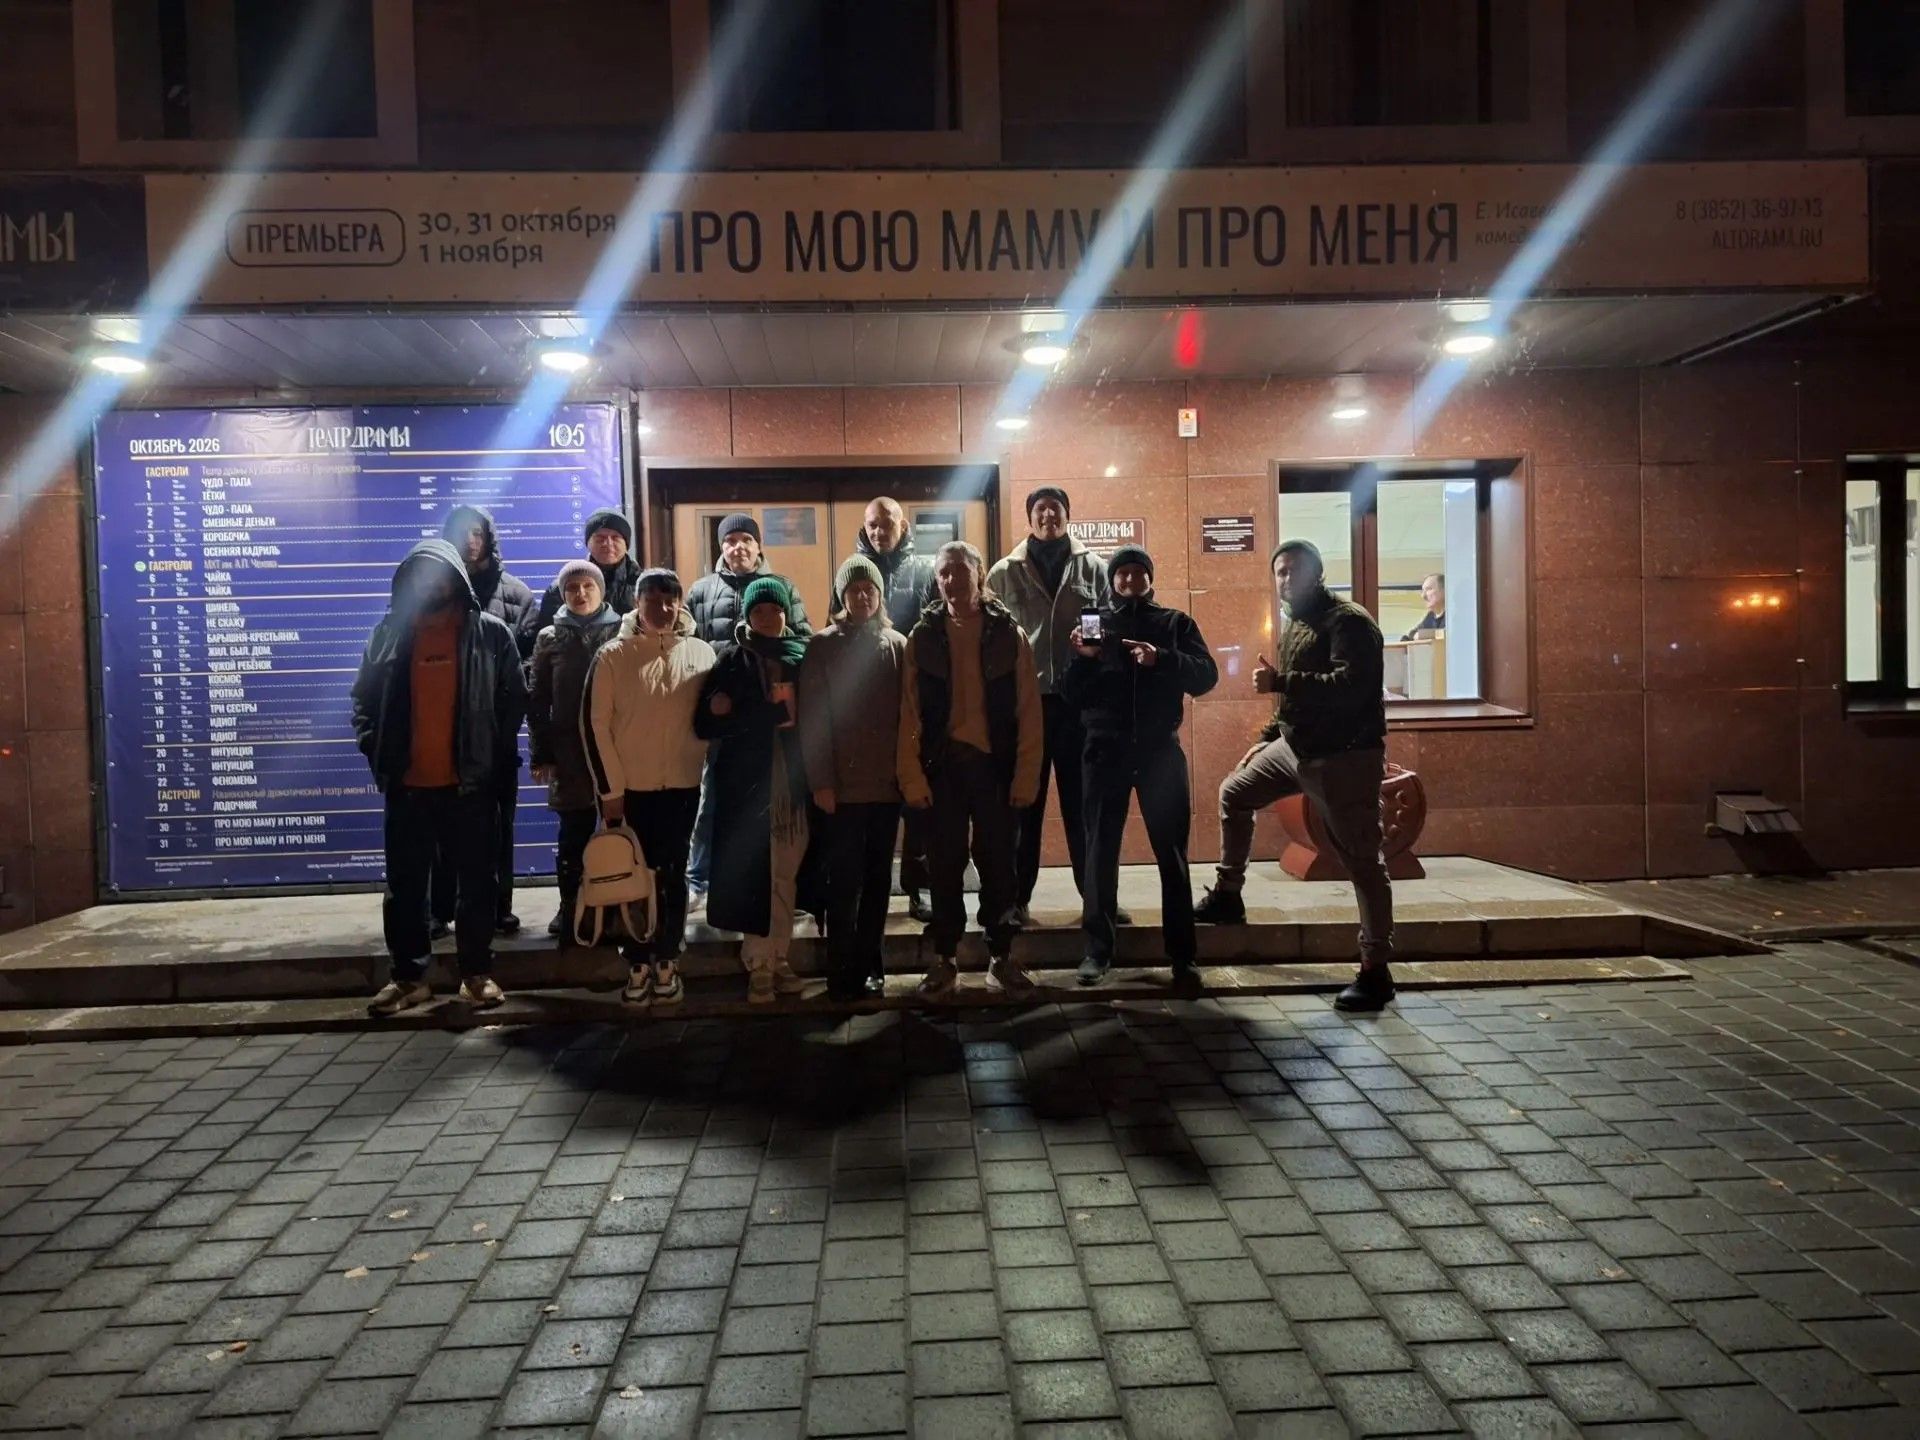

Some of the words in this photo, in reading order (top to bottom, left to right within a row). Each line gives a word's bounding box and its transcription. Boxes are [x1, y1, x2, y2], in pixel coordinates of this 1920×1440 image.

[1676, 200, 1686, 220] 8
[1692, 199, 1746, 222] (3852)
[1752, 197, 1822, 219] 36-97-13
[418, 212, 460, 236] 30,
[467, 212, 492, 235] 31
[502, 206, 616, 238] октября
[0, 212, 75, 262] МЫ
[246, 222, 385, 253] ПРЕМЬЕРА
[649, 209, 761, 273] ПРО
[784, 209, 919, 273] МОЮ
[942, 208, 1101, 272] МАМУ
[1122, 206, 1154, 269] И
[1178, 205, 1286, 269] ПРО
[1309, 202, 1458, 266] МЕНЯ
[419, 243, 429, 263] 1
[440, 237, 543, 268] ноября
[549, 423, 585, 447] 105
[129, 438, 186, 454] ОКТЯБРЬ
[188, 438, 220, 453] 2026
[145, 466, 188, 477] ГАСТРОЛИ
[201, 478, 223, 488] ЧУДО
[230, 477, 251, 487] ПАПА
[202, 505, 224, 515] ЧУДО
[231, 504, 253, 514] ПАПА
[202, 518, 243, 528] СМЕШНЫЕ
[245, 517, 276, 527] ДЕНЬГИ
[203, 532, 250, 542] КОРОБОЧКА
[203, 546, 241, 557] ОСЕННЯЯ
[242, 545, 280, 557] КАДРИЛЬ
[149, 560, 193, 571] ГАСТРОЛИ
[204, 570, 232, 582] ЧАЙКА
[205, 583, 232, 596] ЧАЙКА
[205, 603, 240, 613] ШИНЕЛЬ
[206, 618, 216, 628] НЕ
[218, 618, 245, 628] СКАЖУ
[206, 632, 299, 643] БАРЫШНЯ-КРЕСТЬЯНКА
[208, 660, 236, 671] ЧУЖОЙ
[208, 675, 241, 684] КОСМОС
[209, 688, 244, 698] КРОТКАЯ
[210, 704, 225, 713] ТРИ
[226, 703, 257, 713] СЕСТРЫ
[210, 717, 237, 728] ИДИОТ
[210, 731, 237, 743] ИДИОТ
[212, 775, 257, 786] ФЕНОМЕНЫ
[157, 789, 200, 800] ГАСТРОЛИ
[213, 800, 258, 811] ЛОДОЧНИК
[214, 818, 230, 829] ПРО
[232, 818, 251, 828] МОЮ
[253, 817, 276, 828] МАМУ
[285, 816, 301, 826] ПРО
[303, 815, 326, 825] МЕНЯ
[215, 837, 231, 847] ПРО
[233, 836, 252, 846] МОЮ
[254, 835, 277, 846] МАМУ
[286, 834, 302, 845] ПРО
[304, 834, 326, 844] МЕНЯ
